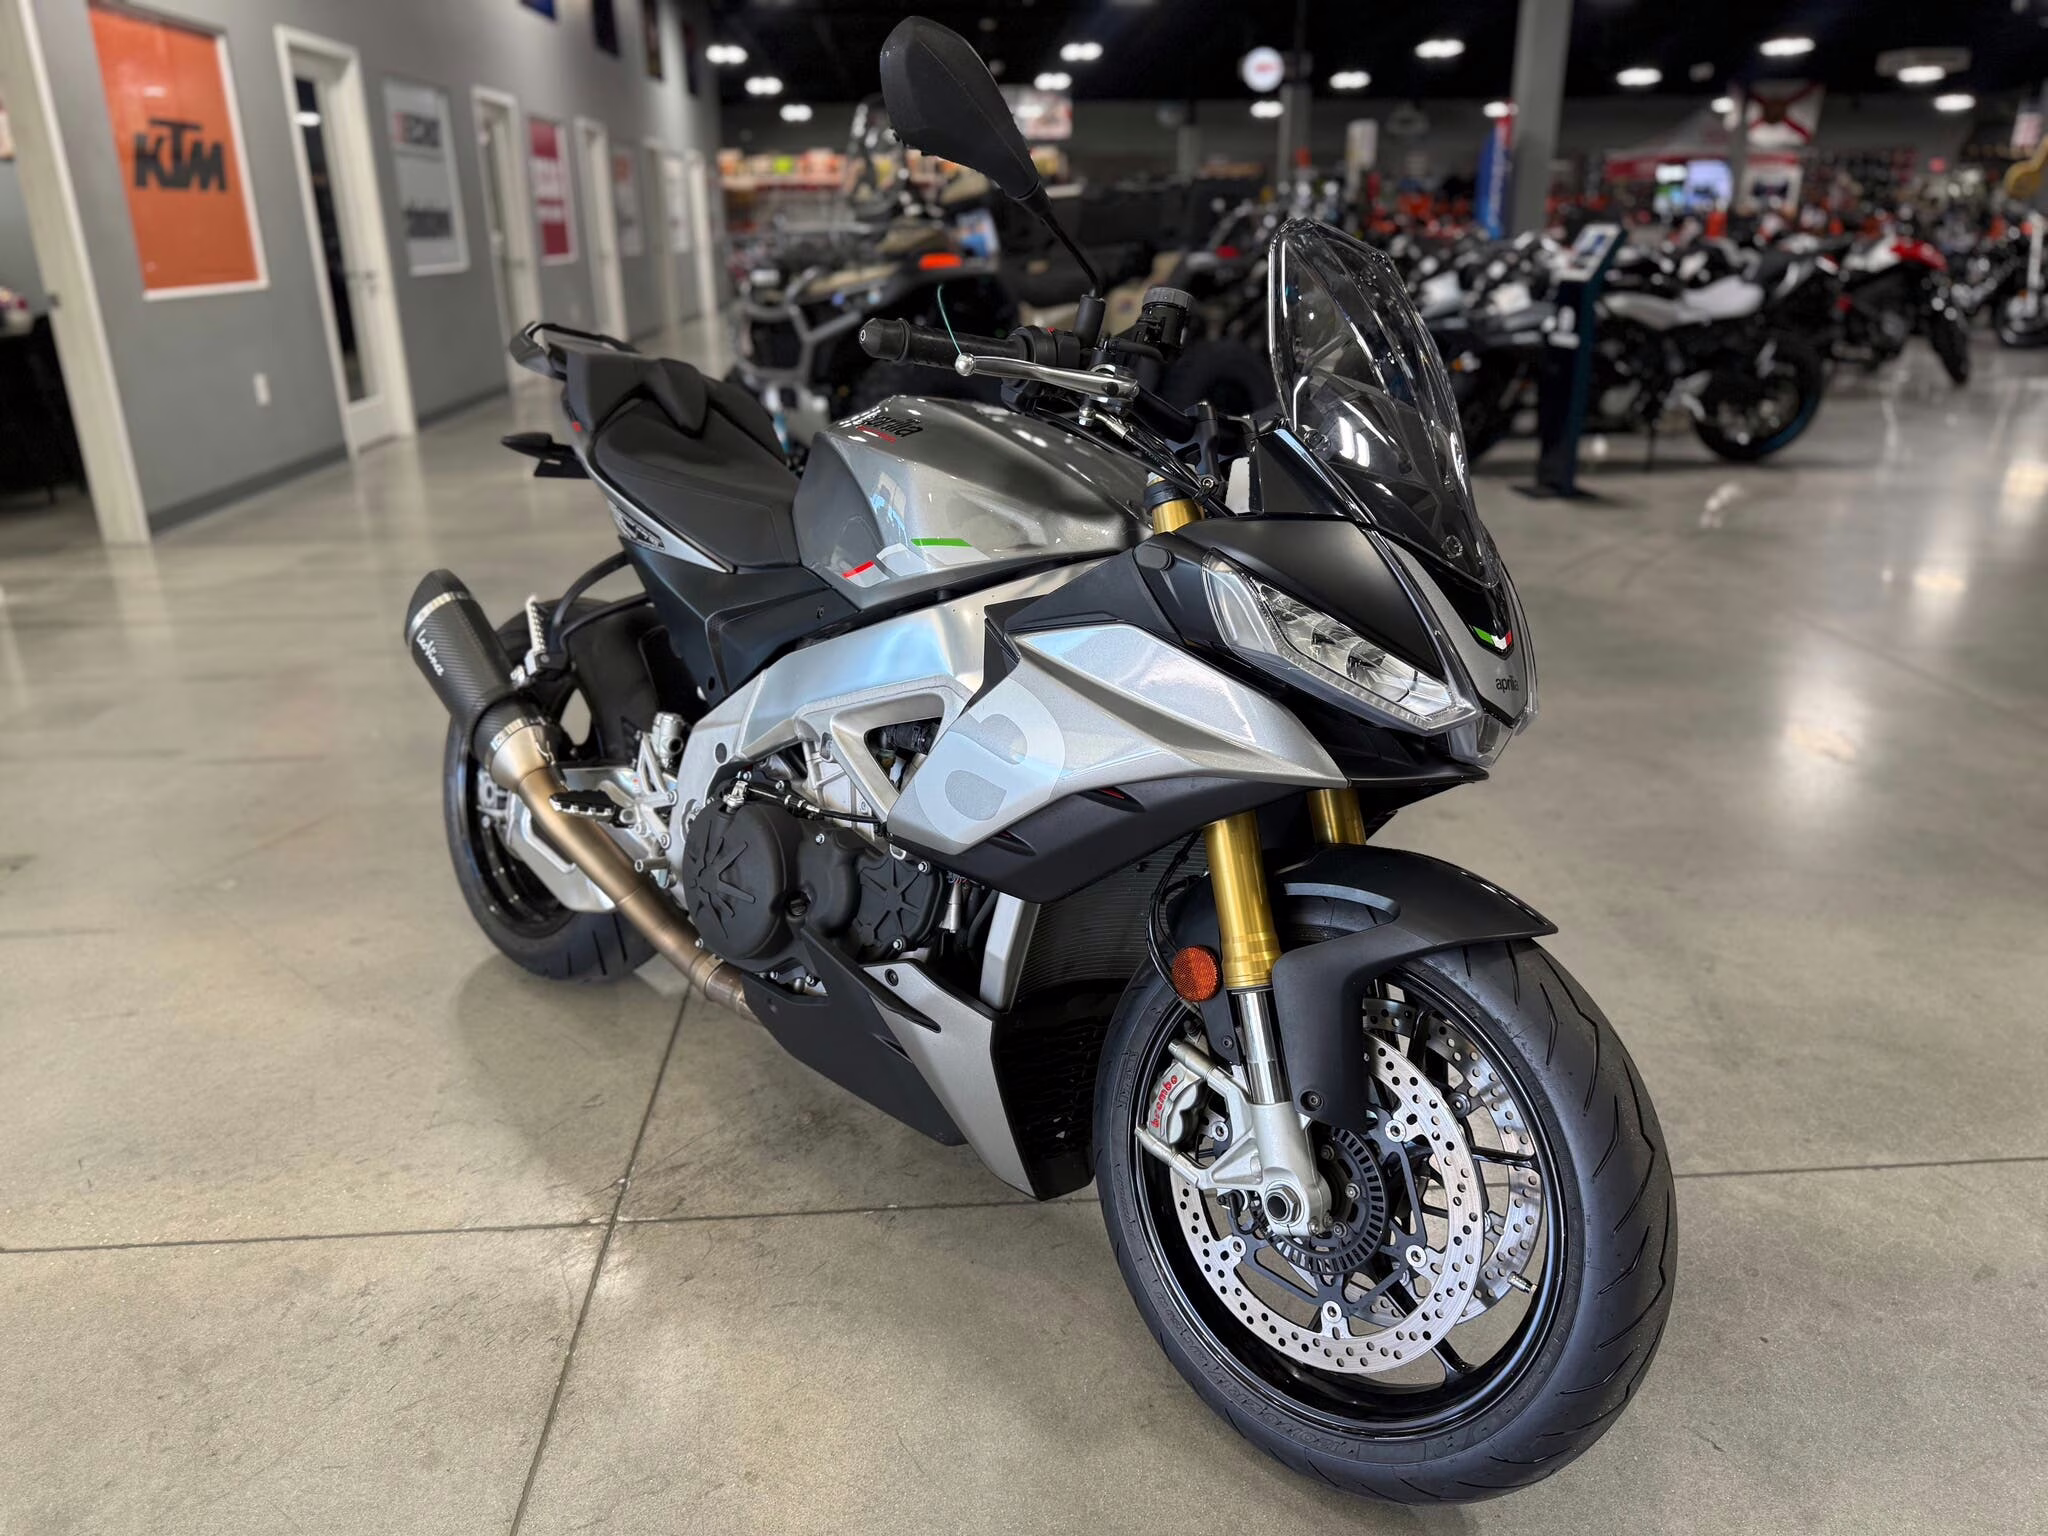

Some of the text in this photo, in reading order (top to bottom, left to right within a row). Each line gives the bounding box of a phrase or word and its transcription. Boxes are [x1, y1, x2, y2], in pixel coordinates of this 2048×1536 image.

[135, 118, 227, 191] KTM
[1495, 675, 1519, 693] aprilia
[1150, 1074, 1179, 1129] brembo
